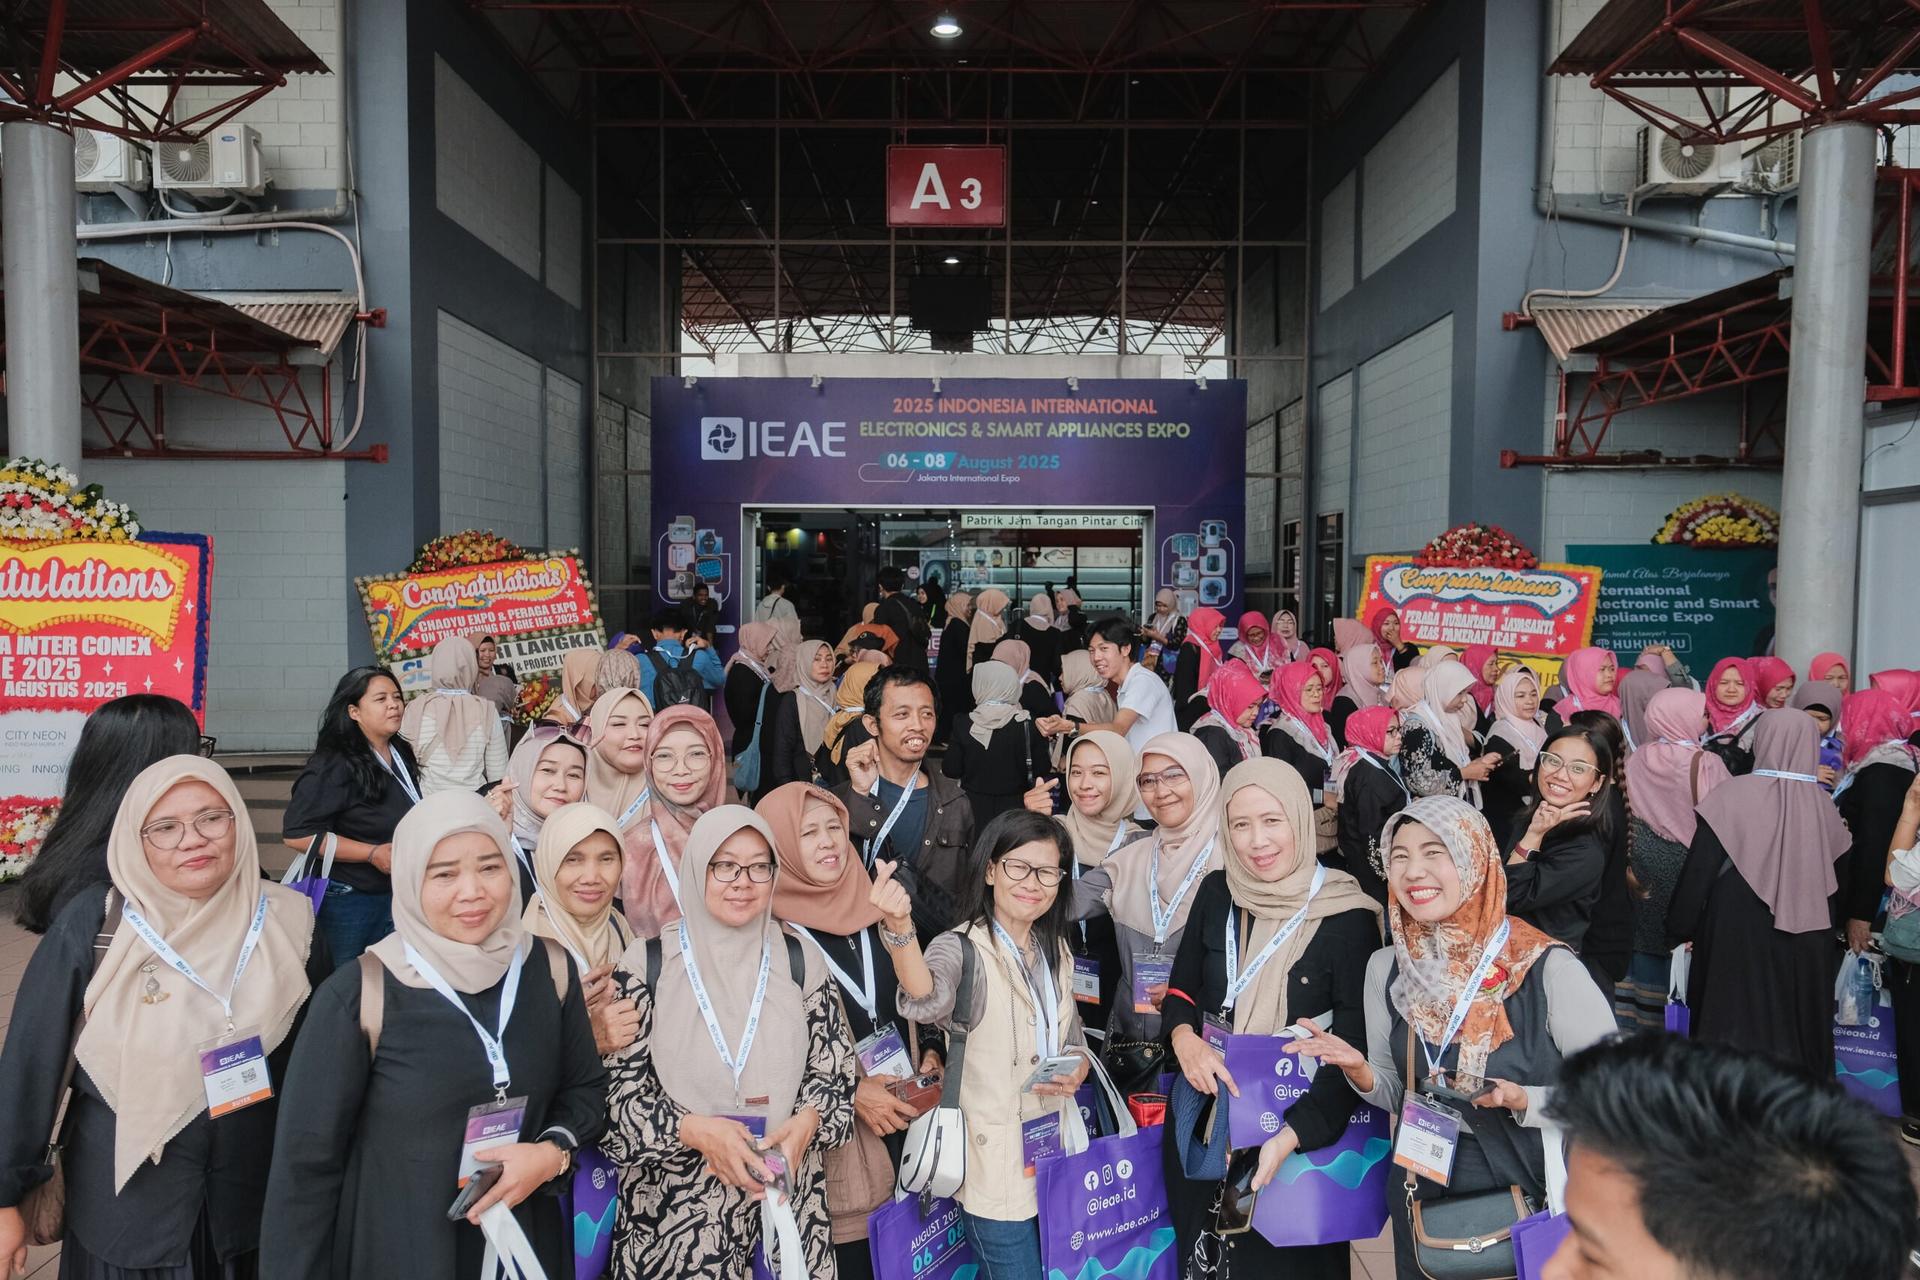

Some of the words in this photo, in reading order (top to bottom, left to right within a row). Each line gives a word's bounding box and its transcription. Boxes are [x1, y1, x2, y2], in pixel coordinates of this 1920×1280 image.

[910, 163, 951, 209] A
[960, 178, 982, 209] 3
[893, 398, 934, 413] 2025
[939, 399, 1025, 413] INDONESIA
[1032, 399, 1157, 414] INTERNATIONAL
[749, 421, 846, 457] IEAE
[860, 422, 967, 437] ELECTRONICS
[971, 423, 982, 437] &
[987, 422, 1043, 437] SMART
[1047, 422, 1143, 437] APPLIANCES
[1147, 423, 1190, 437] EXPO
[887, 453, 908, 467] 06
[924, 453, 946, 467] 08
[957, 455, 1012, 473] August
[1017, 455, 1060, 469] 2025
[917, 474, 948, 482] Jakarta
[950, 474, 1000, 482] International
[1001, 475, 1020, 483] Expo
[967, 516, 1003, 525] Pabrik
[1037, 516, 1077, 528] Tangan
[1082, 516, 1119, 525] Pintar
[402, 567, 562, 608] Congratulations
[1400, 567, 1562, 597] Congratulations
[1599, 585, 1691, 596] ternational
[1597, 599, 1669, 609] lectronic
[1674, 599, 1704, 609] and
[1709, 598, 1760, 609] Smart
[418, 614, 466, 632] CHAOYU
[469, 611, 496, 626] EXPO
[498, 612, 505, 621] &
[508, 607, 549, 618] PERAGA
[551, 601, 578, 613] EXPO
[1673, 612, 1714, 624] Expo
[421, 631, 436, 643] ON
[437, 629, 456, 640] THE
[456, 623, 498, 638] OPENING
[500, 621, 511, 631] OF
[555, 612, 579, 625] 2025
[1442, 627, 1490, 644] PAMERAN
[16, 635, 77, 655] INTER
[82, 636, 152, 656] CONEX
[516, 632, 598, 656] LANGKA
[1613, 639, 1686, 649] HUKUMKU
[22, 656, 81, 680] 2025
[524, 654, 559, 670] PROJECT
[4, 681, 79, 697] AGUSTUS
[84, 682, 127, 697] 2025
[5, 730, 29, 740] CITY
[32, 730, 67, 740] NEON
[1832, 1026, 1881, 1040] @ieae.id
[1087, 1183, 1136, 1215] @ieae.id
[911, 1218, 940, 1253] AUGUST
[942, 1207, 959, 1226] 202
[1087, 1207, 1160, 1241] www.ieae.co.id
[913, 1246, 933, 1273] 06
[947, 1220, 965, 1246] 08
